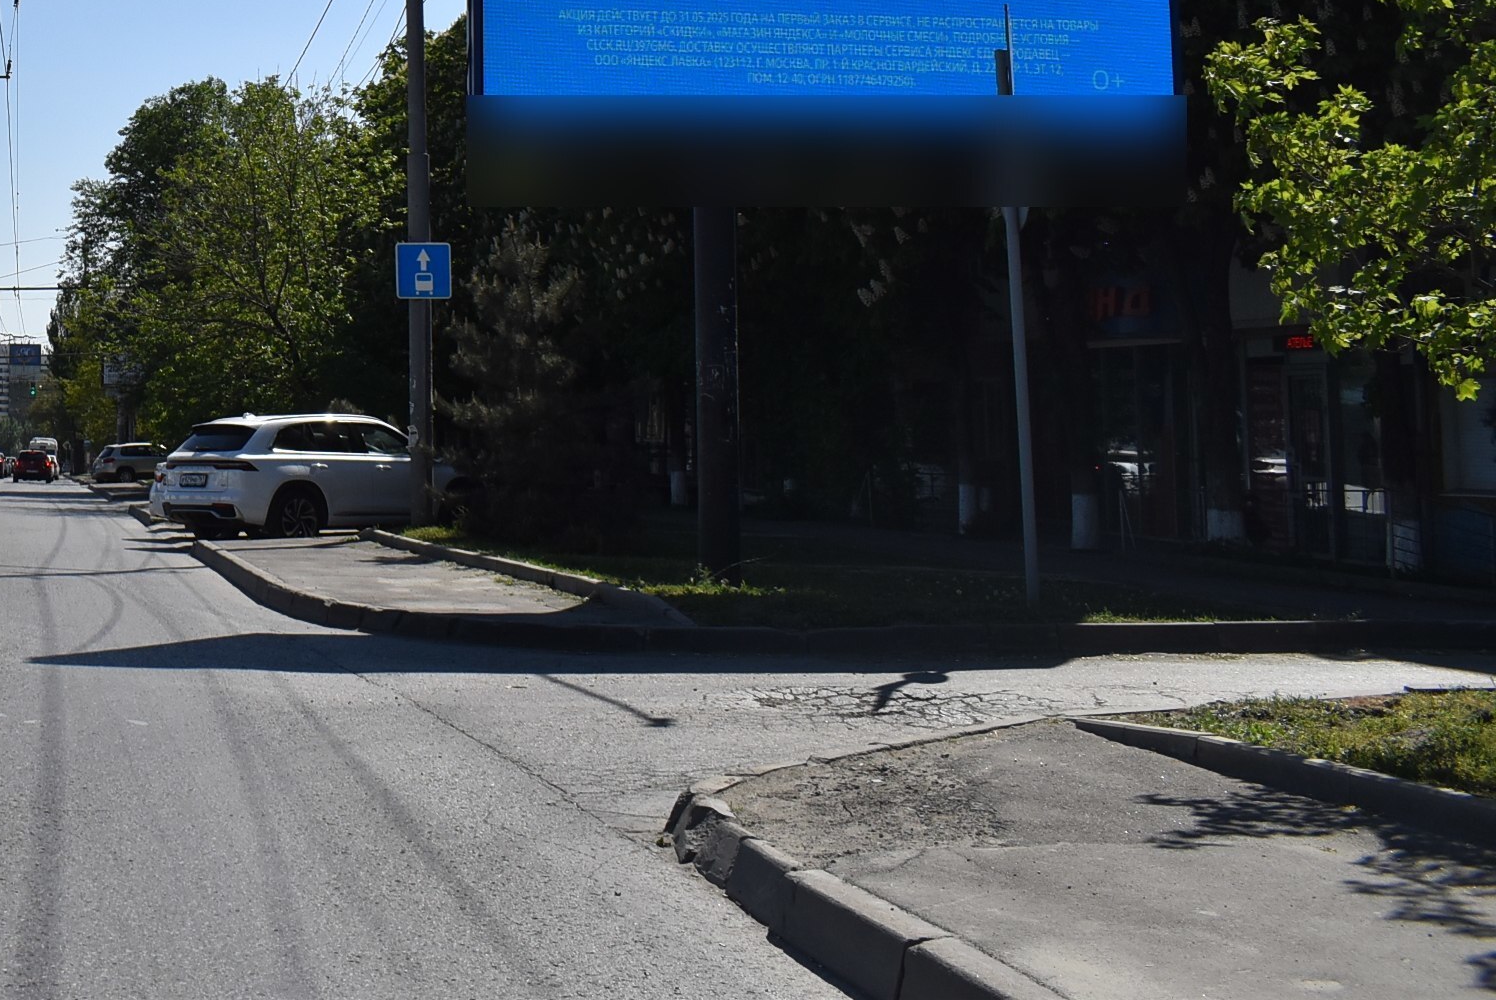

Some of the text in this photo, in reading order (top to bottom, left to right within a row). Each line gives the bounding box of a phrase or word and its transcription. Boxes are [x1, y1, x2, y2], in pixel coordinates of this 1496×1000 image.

[558, 9, 595, 22] АКЦИЯ
[597, 8, 657, 22] ДЕЙСТВУЕТ
[660, 11, 676, 23] ДО
[730, 12, 758, 24] ГОДА
[777, 11, 821, 25] ПЕРВЫЙ
[823, 14, 856, 26] ЗАКАЗ
[917, 16, 930, 28] НЕ
[932, 17, 1038, 31] РАСПРОСТРАНЕТСЯ
[1040, 19, 1054, 30] НА
[1056, 19, 1099, 31] ТОВАРЫ
[594, 23, 655, 37] КАТЕГОРИЙ
[953, 32, 1019, 44] ПОДРОБНЕ
[594, 54, 619, 66] ООО
[1092, 70, 1125, 90] 0+
